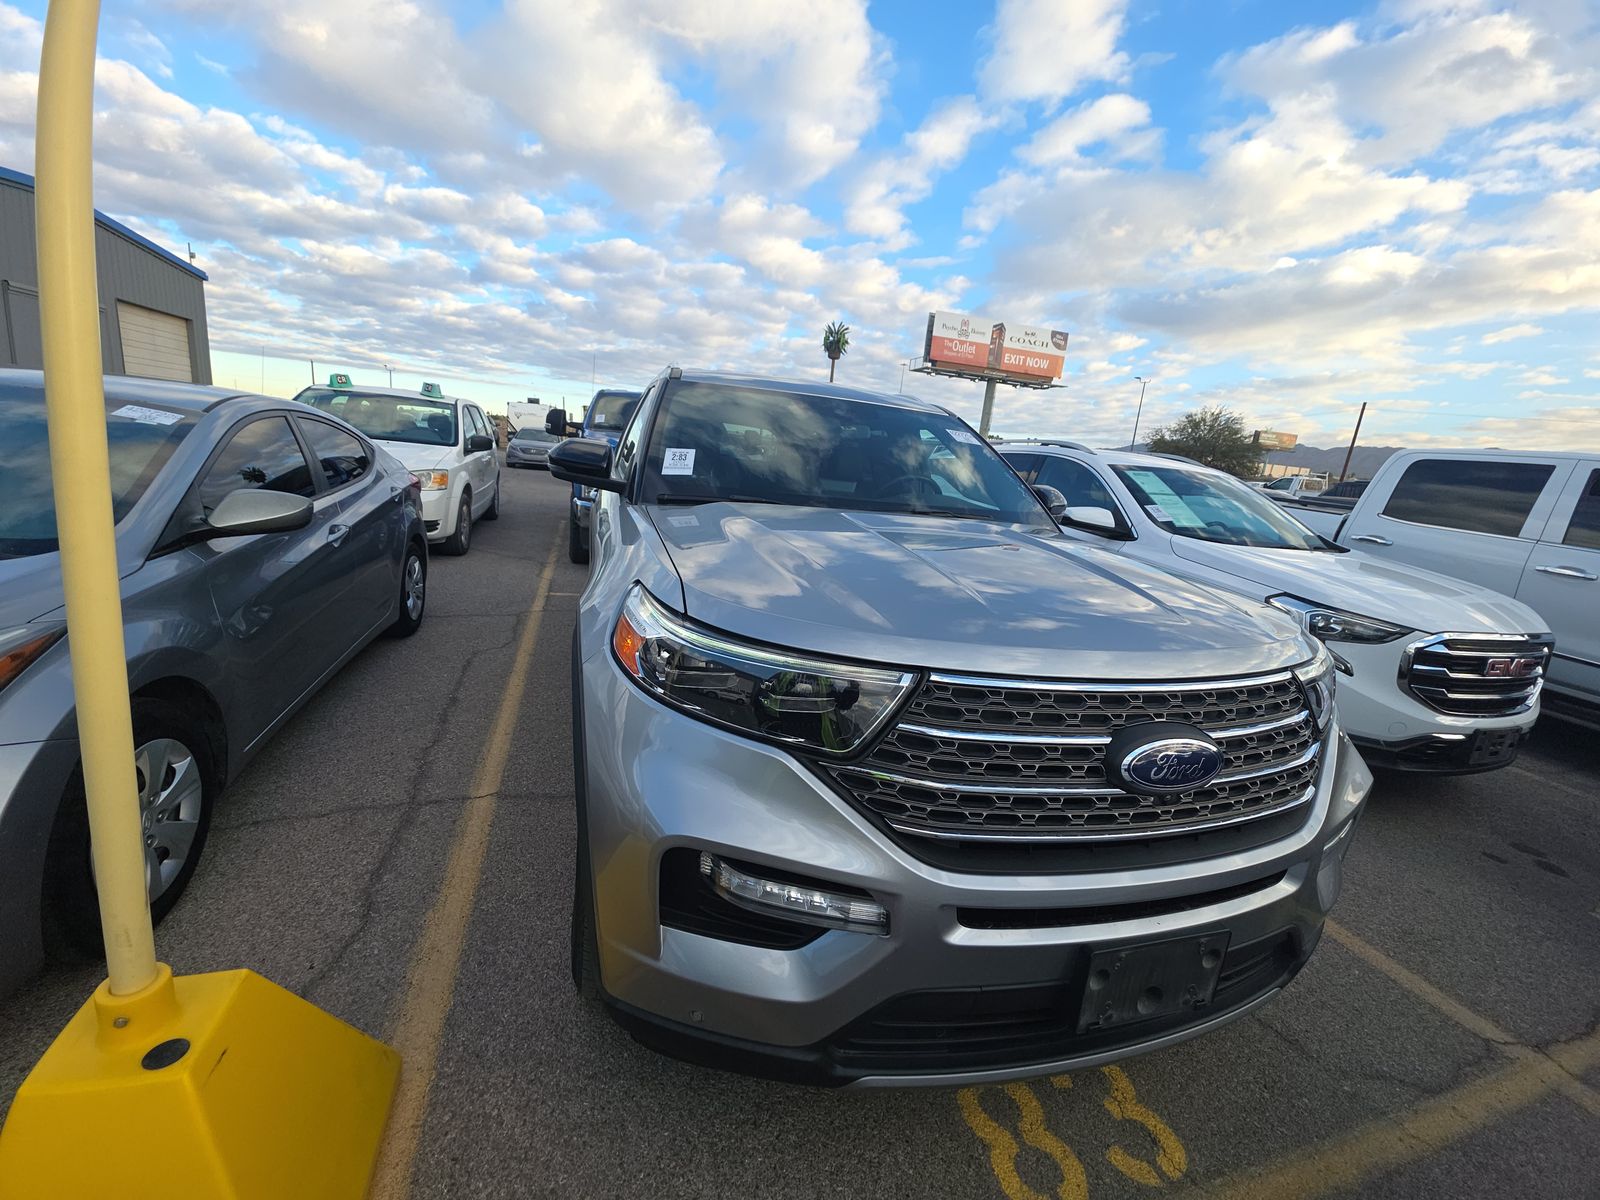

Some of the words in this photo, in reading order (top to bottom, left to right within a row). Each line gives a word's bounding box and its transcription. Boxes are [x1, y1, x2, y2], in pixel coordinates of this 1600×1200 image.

[952, 341, 976, 354] Outlet
[1010, 336, 1049, 348] COACH
[1004, 353, 1025, 365] EXIT
[1026, 357, 1049, 369] NOW
[337, 375, 347, 383] CR
[1484, 658, 1537, 677] GMC
[1150, 751, 1206, 780] Ford
